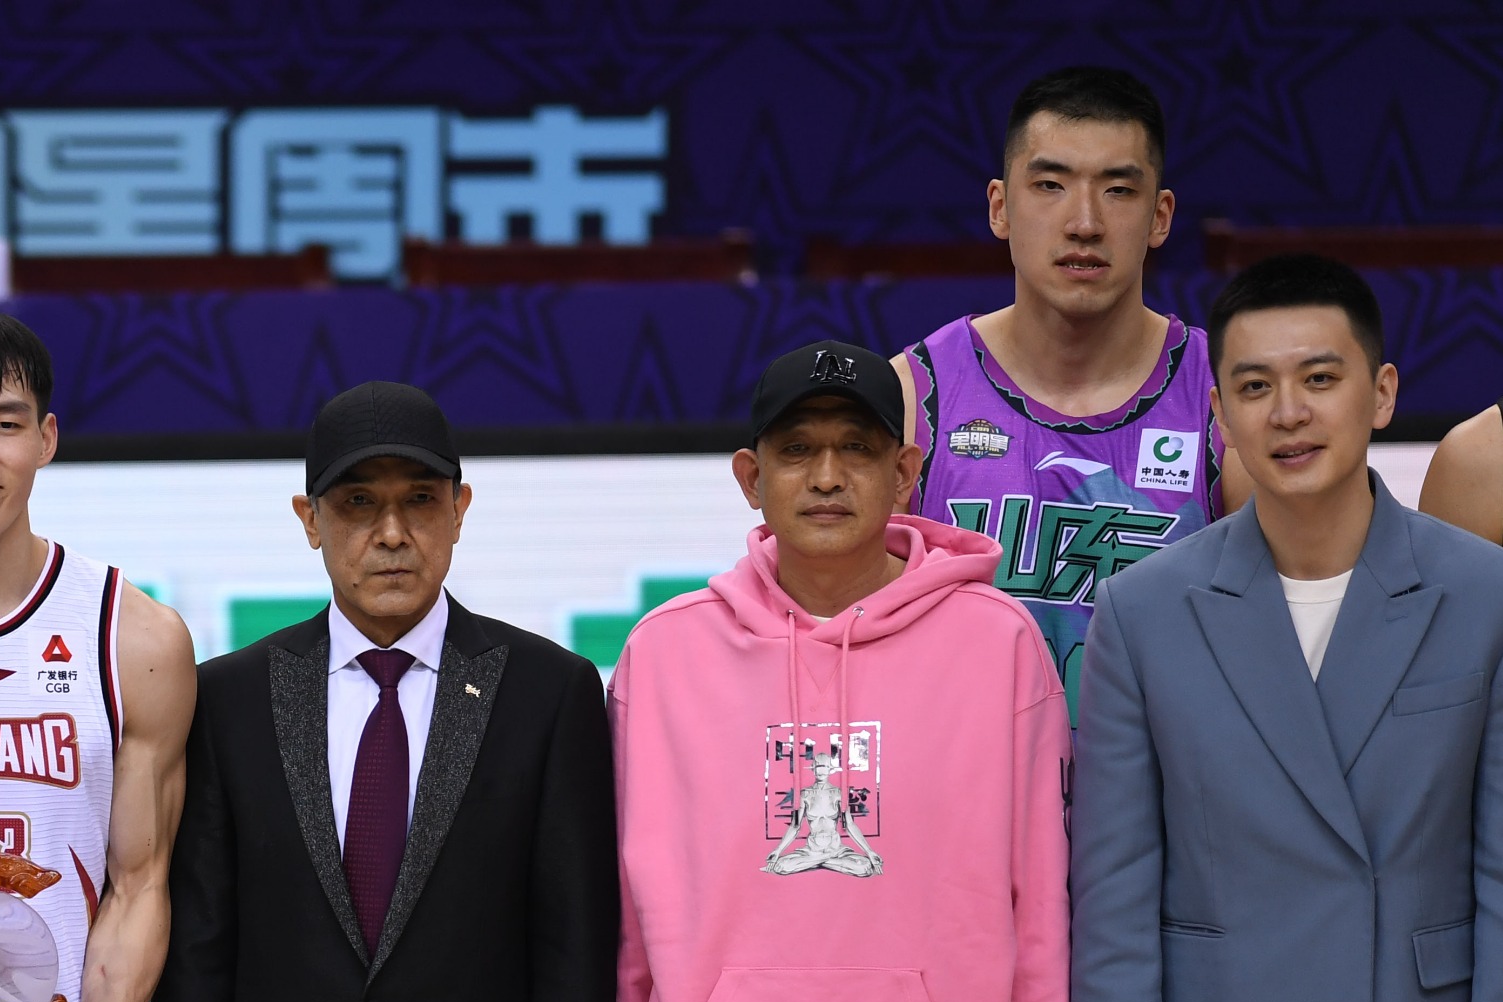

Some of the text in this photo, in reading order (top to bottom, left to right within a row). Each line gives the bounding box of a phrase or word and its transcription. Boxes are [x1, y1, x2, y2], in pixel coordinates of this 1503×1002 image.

[949, 431, 1010, 452] 全明星
[1141, 466, 1190, 479] 中国人寿
[37, 670, 78, 681] 广发银行
[45, 683, 70, 693] CGB
